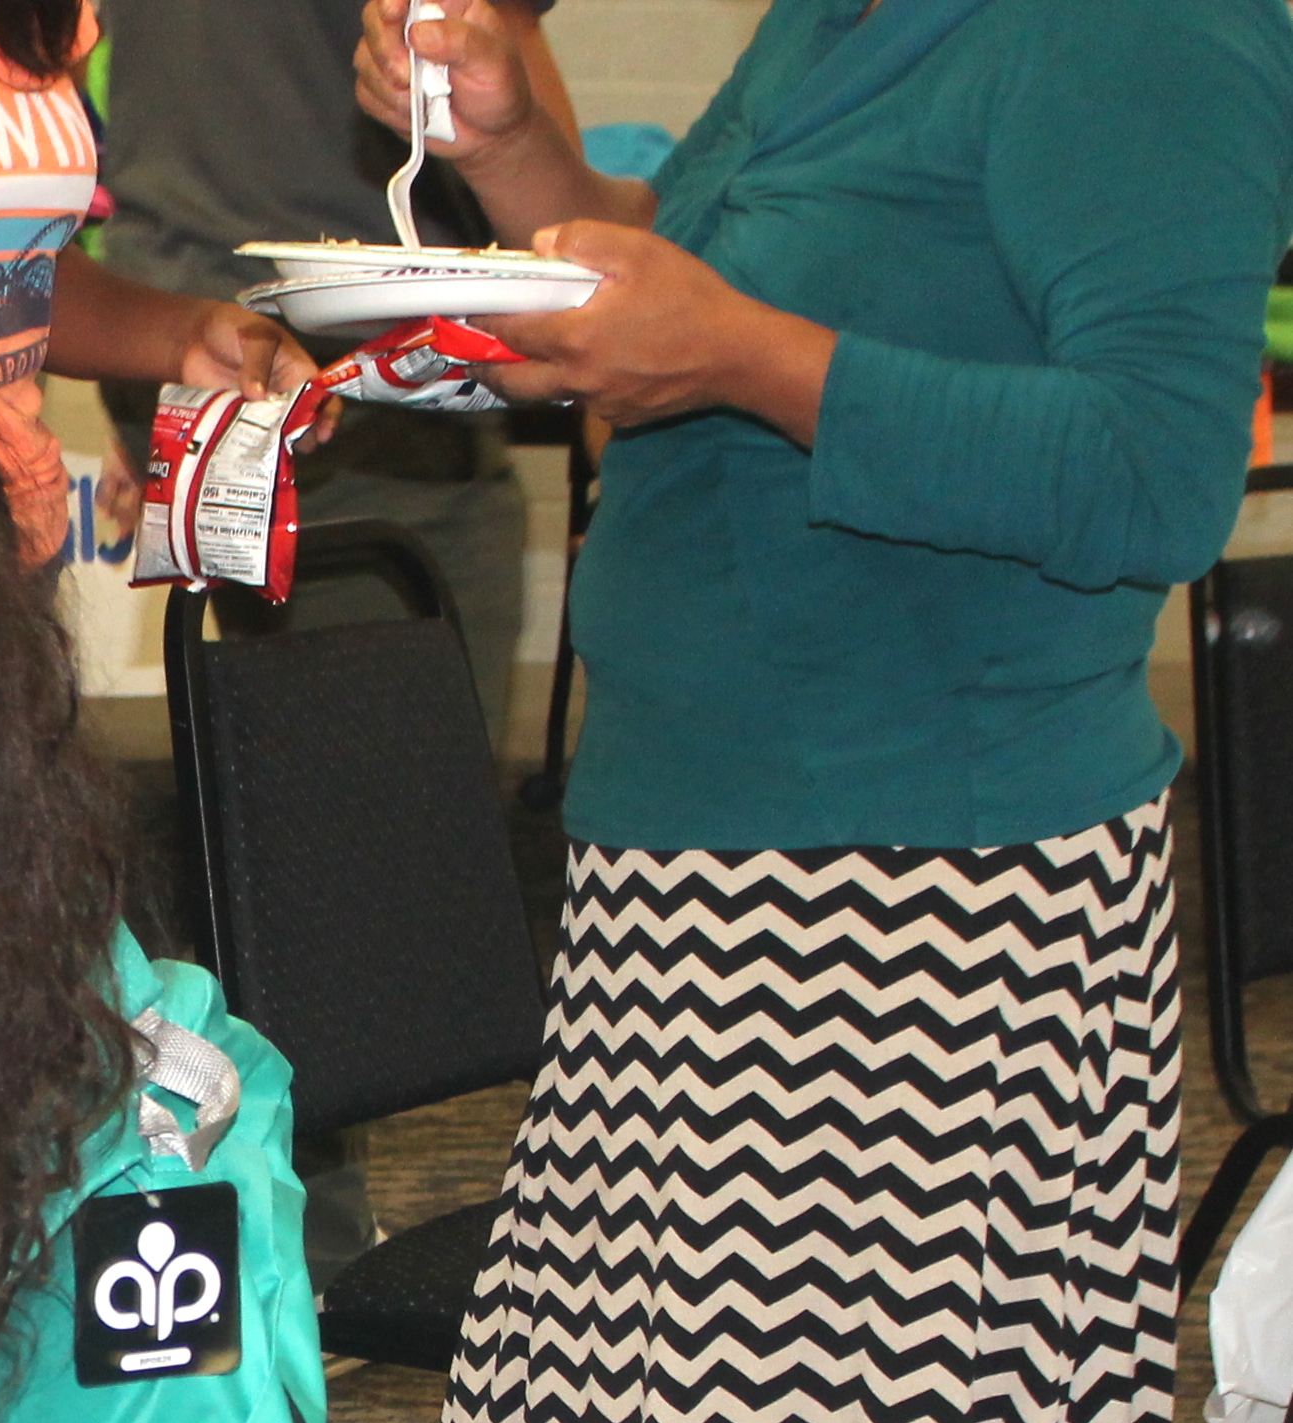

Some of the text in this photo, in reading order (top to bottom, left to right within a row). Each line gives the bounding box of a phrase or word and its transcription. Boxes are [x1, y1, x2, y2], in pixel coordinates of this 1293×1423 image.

[203, 486, 266, 501] Calories 150
[219, 526, 262, 539] Nutrition
